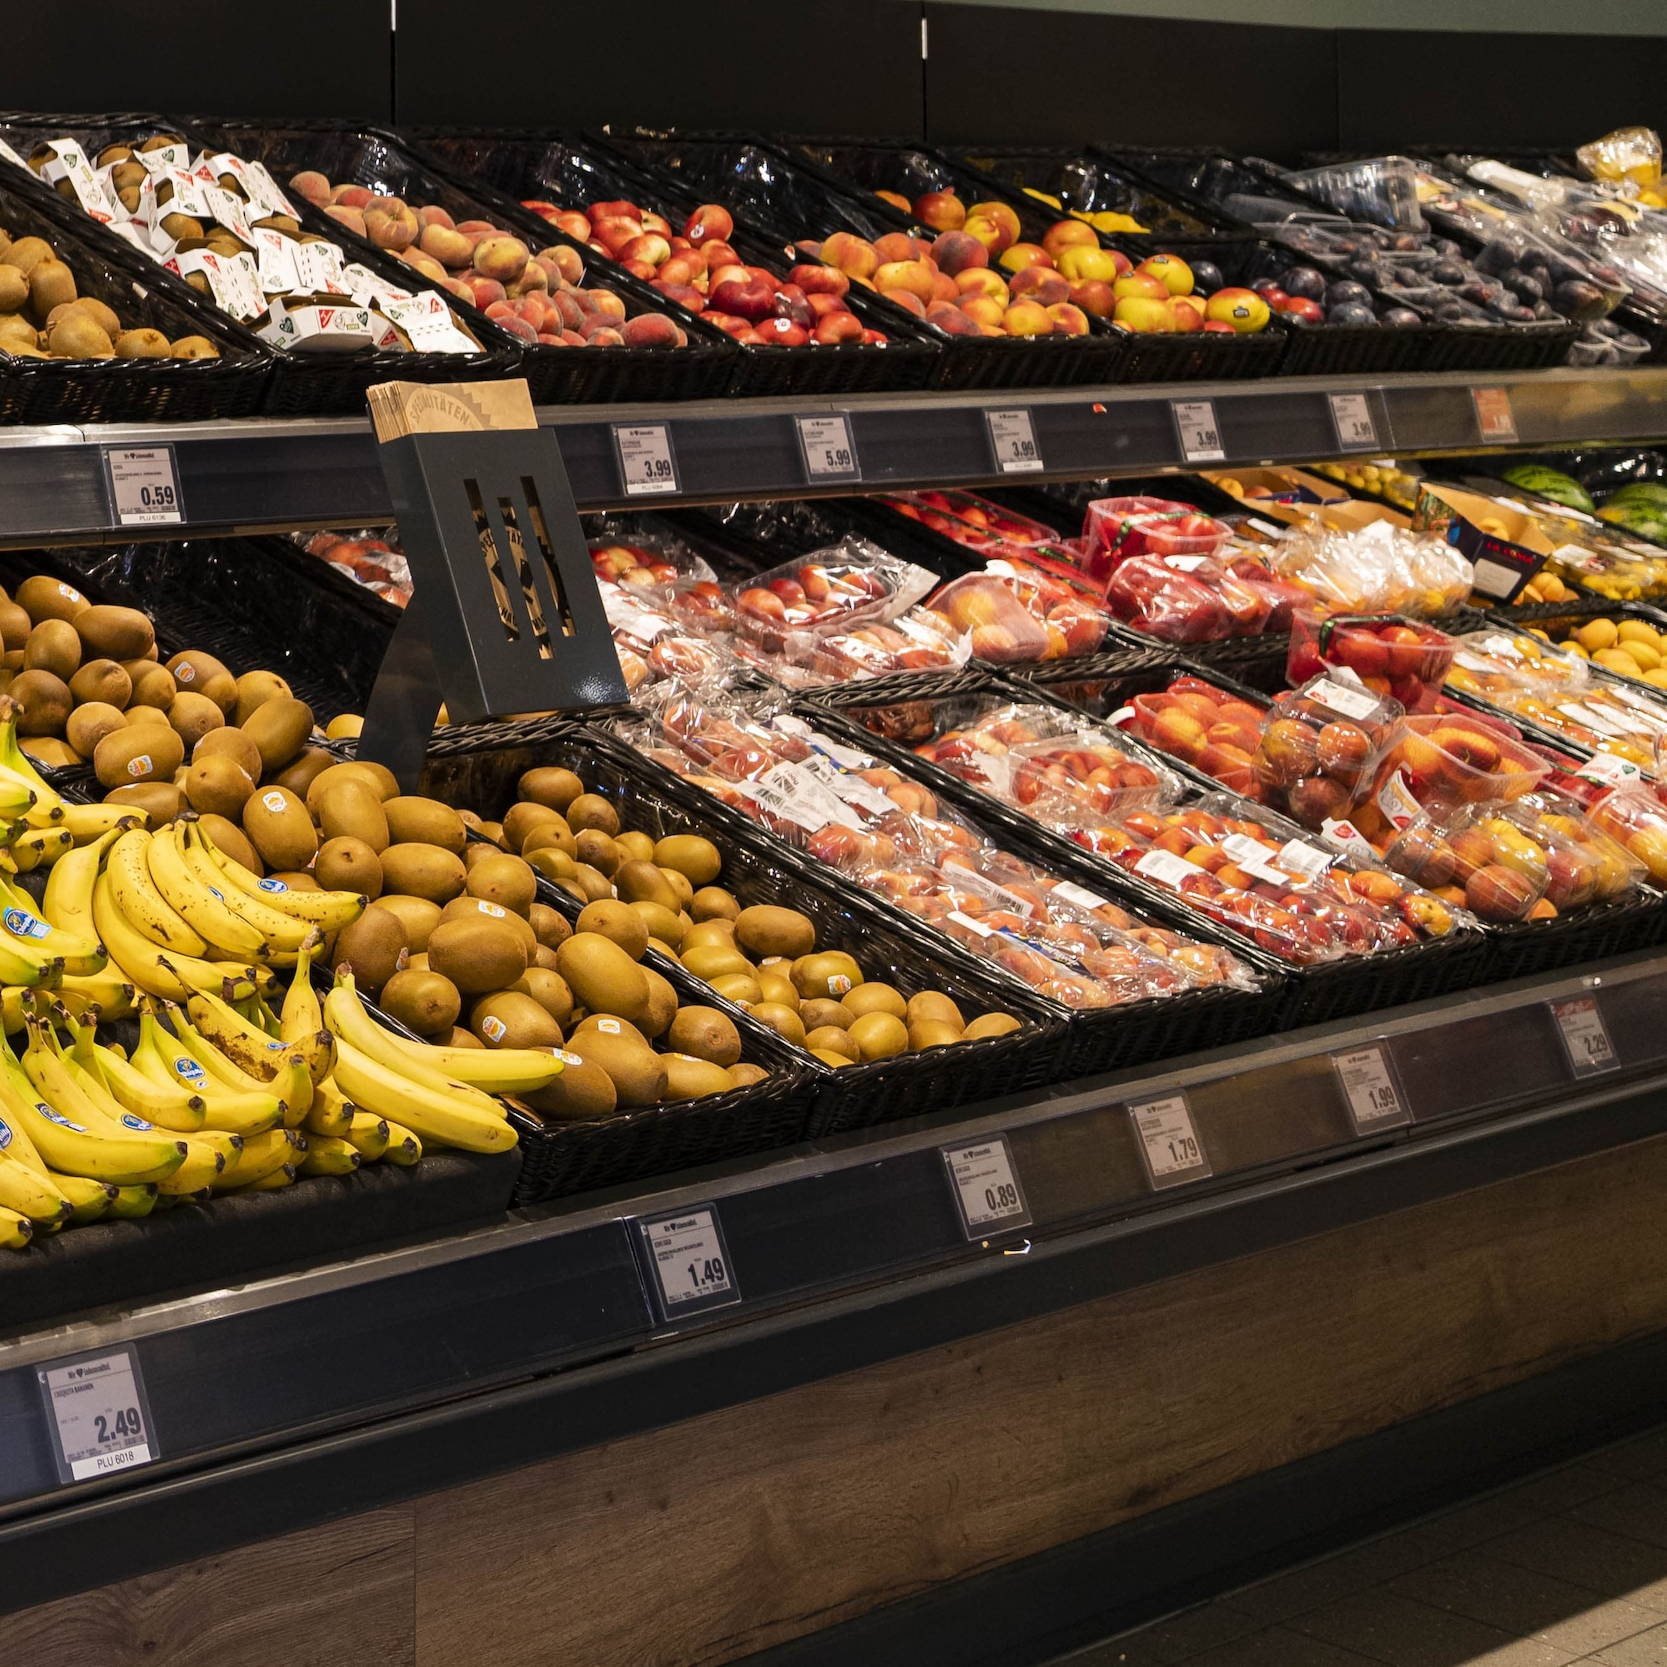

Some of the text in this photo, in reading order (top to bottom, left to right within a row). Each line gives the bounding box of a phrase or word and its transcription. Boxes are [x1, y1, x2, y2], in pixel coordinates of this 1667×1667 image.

[1197, 431, 1216, 446] 3.99
[825, 450, 850, 466] 5.99
[1012, 442, 1034, 456] 3.99
[644, 460, 671, 477] 3.99
[140, 486, 174, 506] 0.59
[1584, 1035, 1608, 1056] 2.29
[1369, 1086, 1396, 1109] 1.99
[1168, 1137, 1198, 1161] 1.79
[985, 1183, 1017, 1210] 0.89
[688, 1258, 724, 1287] 1.49
[94, 1407, 142, 1443] 2.49
[97, 1451, 135, 1469] PLU 6018
